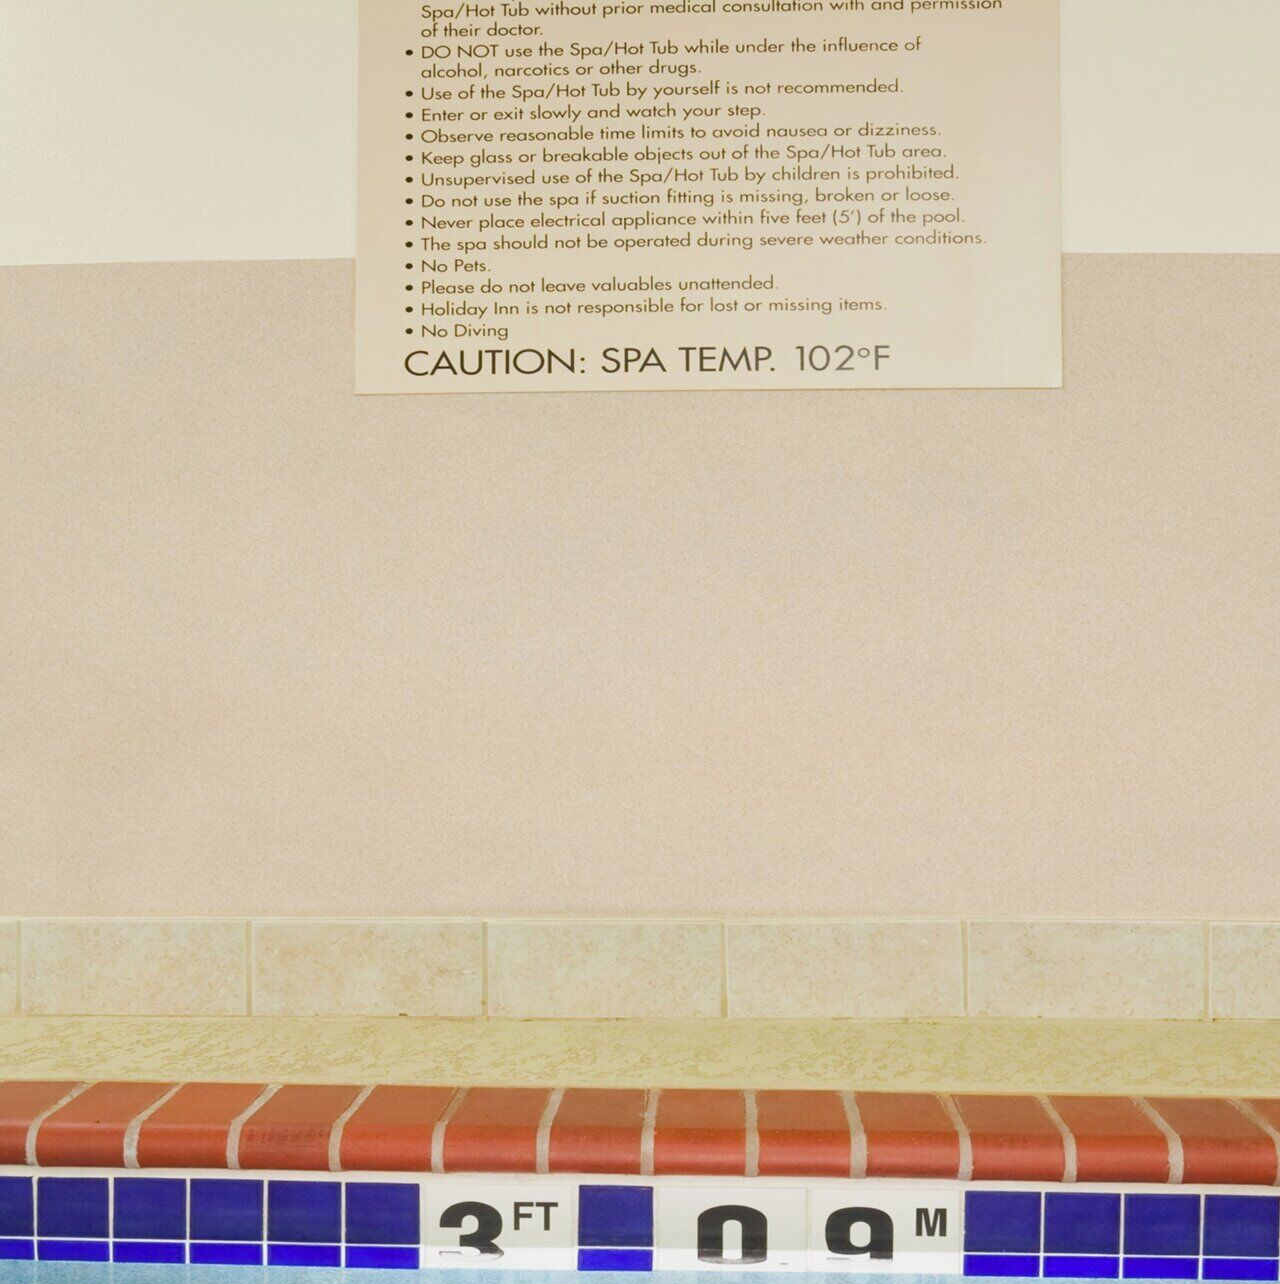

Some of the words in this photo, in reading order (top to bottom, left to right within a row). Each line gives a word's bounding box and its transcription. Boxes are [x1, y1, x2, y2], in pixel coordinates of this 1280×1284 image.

[422, 3, 495, 22] Spa/Hot
[500, 1, 529, 17] Tub
[535, 0, 597, 16] without
[603, 1, 644, 19] prior
[650, 0, 716, 14] medical
[722, 0, 823, 13] consultation
[829, 0, 864, 11] with
[871, 0, 904, 10] and
[911, 0, 1002, 14] permission
[421, 22, 438, 38] of
[443, 22, 481, 37] their
[487, 22, 543, 36] doctor.
[422, 45, 451, 59] DO
[457, 44, 499, 58] NOT
[505, 48, 533, 57] use
[539, 41, 564, 56] the
[570, 40, 644, 60] Spa/Hot
[649, 39, 679, 54] Tub
[684, 38, 729, 54] while
[736, 38, 785, 53] under
[791, 37, 816, 52] the
[823, 36, 898, 52] influence
[904, 35, 921, 51] of
[421, 62, 487, 79] alcohol,
[495, 63, 570, 77] narcotics
[576, 66, 594, 75] or
[599, 59, 643, 75] other
[649, 59, 701, 78] drugs.
[422, 87, 452, 100] Use
[458, 84, 475, 99] of
[480, 84, 505, 99] the
[512, 83, 586, 102] Spa/Hot
[591, 81, 620, 97] Tub
[627, 81, 647, 100] by
[653, 80, 720, 100] yourself
[726, 82, 738, 95] is
[745, 83, 772, 94] not
[777, 78, 903, 94] recommended.
[422, 108, 464, 122] Enter
[470, 112, 488, 121] or
[494, 107, 524, 120] exit
[530, 104, 582, 123] slowly
[587, 103, 620, 119] and
[626, 102, 676, 118] watch
[683, 107, 722, 121] your
[728, 105, 765, 120] step.
[421, 128, 493, 143] Observe
[500, 125, 594, 142] reasonable
[600, 126, 635, 140] time
[642, 124, 684, 139] limits
[690, 127, 706, 138] to
[712, 122, 759, 138] avoid
[767, 128, 827, 137] nausea
[834, 127, 852, 137] or
[858, 121, 941, 136] dizziness.
[422, 151, 464, 168] Keep
[470, 148, 512, 168] glass
[519, 154, 537, 163] or
[543, 146, 628, 162] breakable
[634, 145, 693, 165] objects
[699, 148, 727, 160] out
[732, 144, 749, 159] of
[755, 144, 780, 159] the
[786, 144, 861, 163] Spa/Hot
[866, 142, 896, 158] Tub
[902, 148, 946, 158] area.
[422, 169, 535, 190] Unsupervised
[542, 175, 569, 184] use
[575, 168, 592, 183] of
[598, 168, 623, 183] the
[630, 167, 704, 186] Spa/Hot
[709, 166, 739, 181] Tub
[745, 166, 766, 185] by
[772, 165, 840, 181] children
[848, 167, 860, 180] is
[866, 164, 959, 184] prohibited.
[422, 194, 445, 208] Do
[452, 195, 478, 207] not
[484, 197, 511, 207] use
[517, 191, 543, 206] the
[549, 196, 579, 210] spa
[586, 189, 596, 205] if
[602, 191, 660, 204] suction
[667, 188, 714, 207] fitting
[721, 190, 733, 203] is
[740, 189, 808, 206] missing,
[816, 186, 874, 202] broken
[881, 192, 899, 201] or
[906, 186, 954, 201] loose.
[422, 216, 473, 229] Never
[479, 213, 525, 232] place
[531, 211, 605, 228] electrical
[612, 210, 696, 230] appliance
[702, 209, 753, 224] within
[760, 209, 790, 224] five
[796, 208, 827, 224] feet
[868, 208, 885, 223] of
[891, 208, 916, 223] the
[923, 207, 965, 227] pool.
[421, 236, 451, 251] The
[457, 241, 486, 254] spa
[493, 233, 548, 250] should
[555, 237, 581, 249] not
[587, 233, 608, 248] be
[614, 232, 690, 252] operated
[697, 231, 753, 250] during
[760, 236, 813, 246] severe
[819, 229, 888, 245] weather
[895, 229, 986, 244] conditions.
[421, 259, 448, 273] No
[455, 259, 491, 272] Pets.
[422, 279, 474, 294] Please
[480, 278, 502, 293] do
[509, 281, 535, 293] not
[542, 277, 586, 292] leave
[591, 275, 672, 291] valuables
[679, 274, 778, 290] unattended.
[422, 300, 488, 319] Holiday
[494, 302, 519, 315] Inn
[526, 301, 538, 314] is
[545, 302, 571, 314] not
[578, 297, 674, 317] responsible
[680, 297, 704, 312] for
[710, 297, 738, 312] lost
[744, 302, 762, 312] or
[769, 298, 832, 315] missing
[840, 298, 887, 311] items.
[422, 324, 448, 338] No
[455, 324, 508, 341] Diving
[404, 348, 585, 376] CAUTION:
[601, 347, 667, 373] SPA
[678, 346, 775, 372] TEMP.
[439, 1201, 504, 1260] 3
[514, 1202, 558, 1231] FT
[915, 1207, 947, 1237] M
